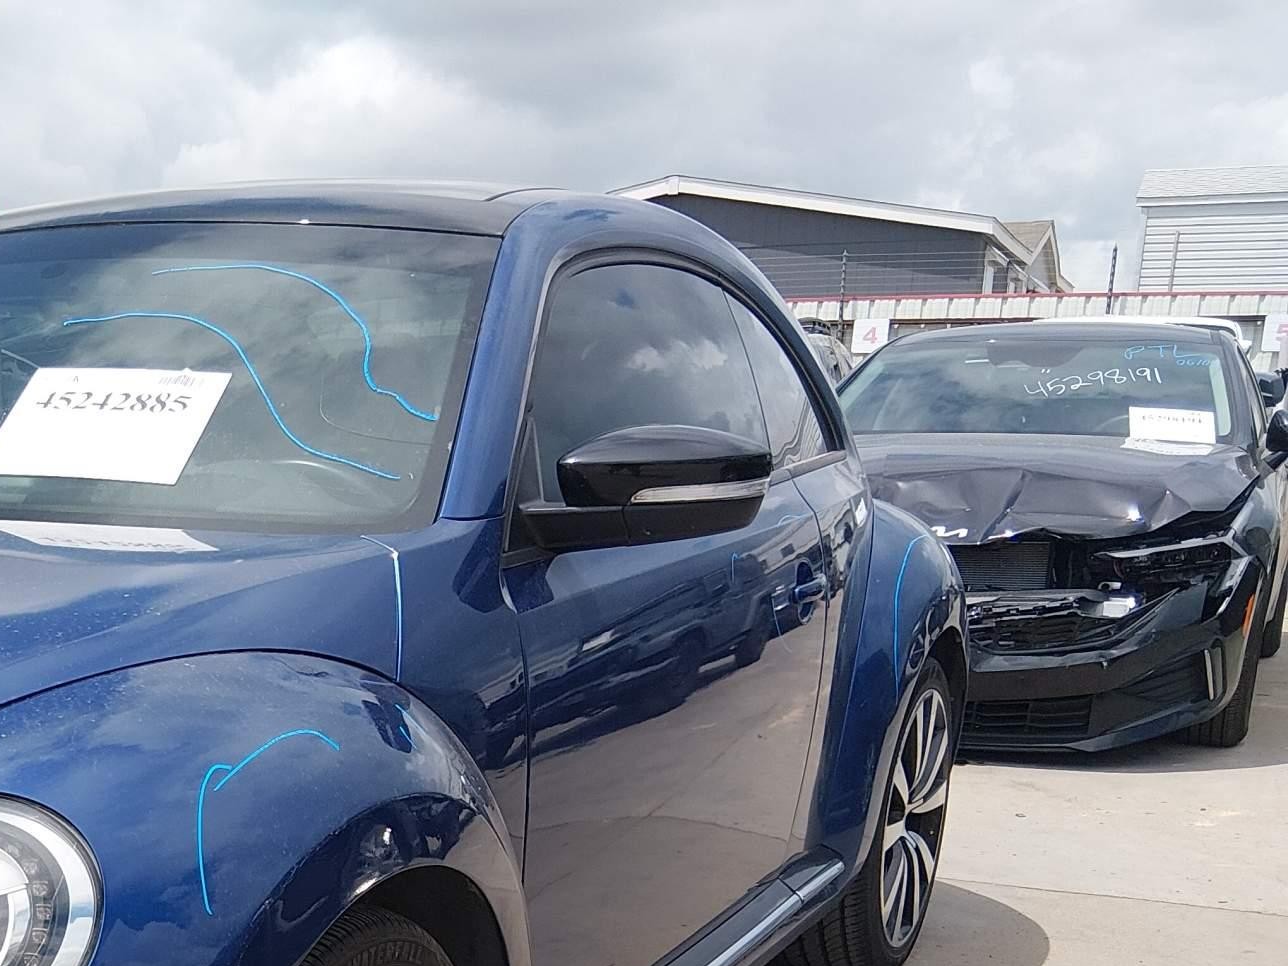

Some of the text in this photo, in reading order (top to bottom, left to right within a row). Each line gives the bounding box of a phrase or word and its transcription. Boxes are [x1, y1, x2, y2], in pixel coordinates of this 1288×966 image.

[862, 326, 878, 344] 4
[1023, 367, 1163, 399] 45298191
[36, 391, 193, 413] 45242885
